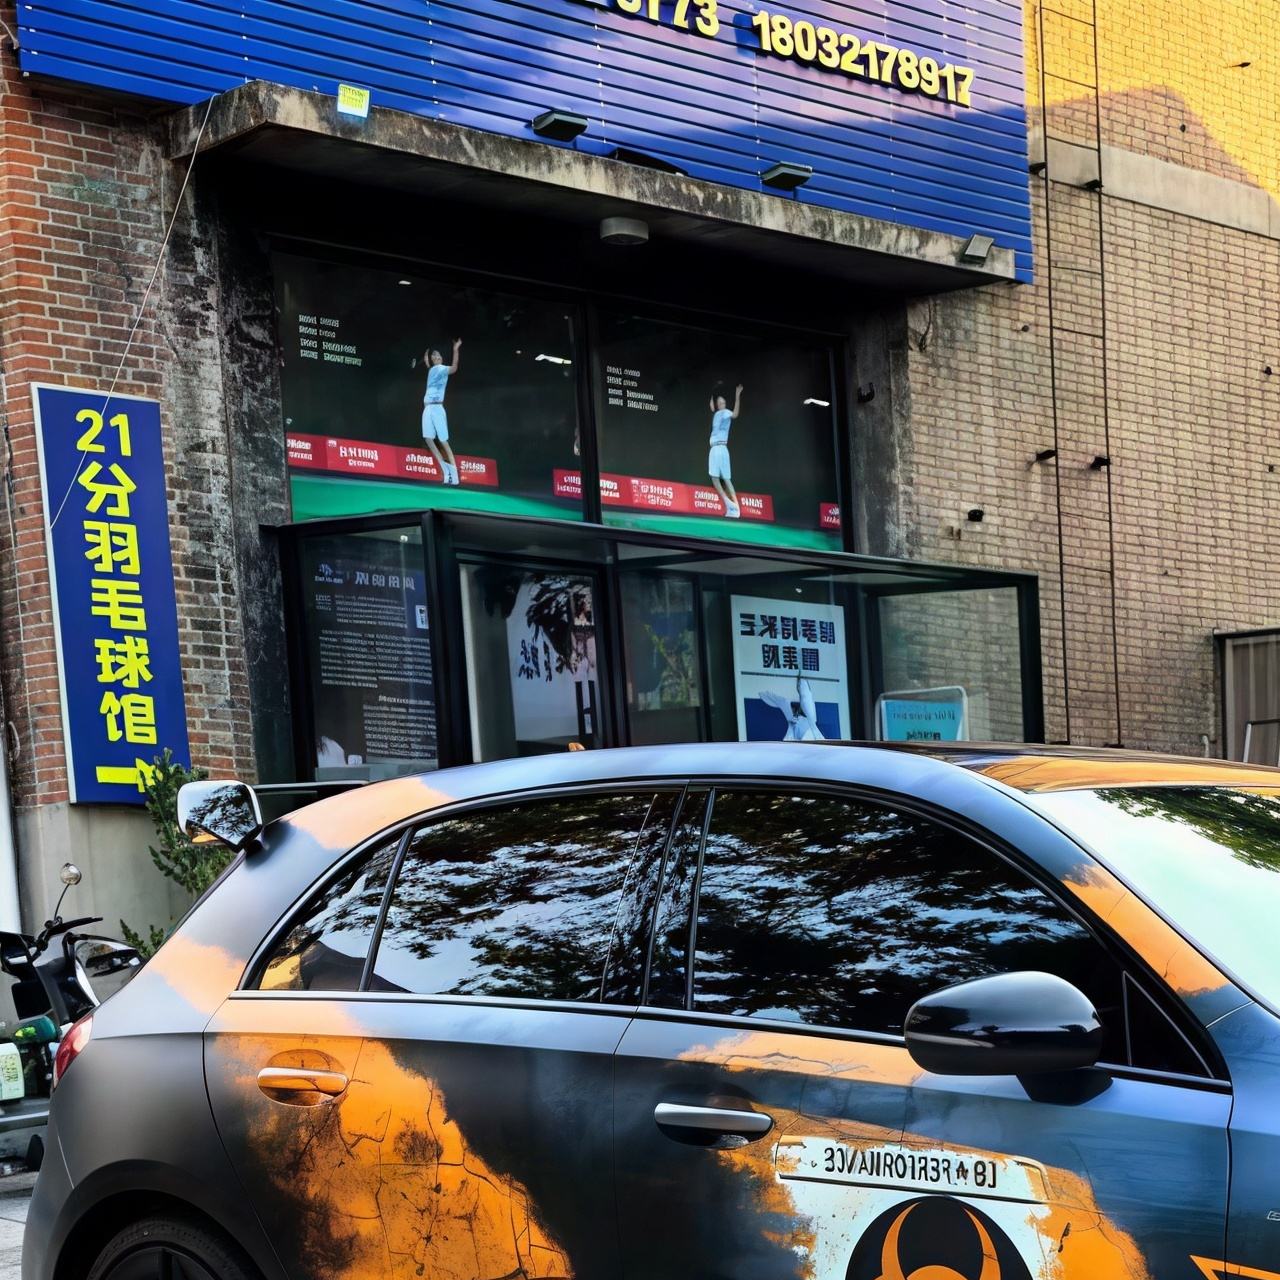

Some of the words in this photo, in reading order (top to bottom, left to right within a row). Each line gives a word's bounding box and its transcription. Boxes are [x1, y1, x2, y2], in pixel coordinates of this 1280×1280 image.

[752, 10, 974, 108] 18032178917
[75, 408, 157, 745] 21分羽毛球馆
